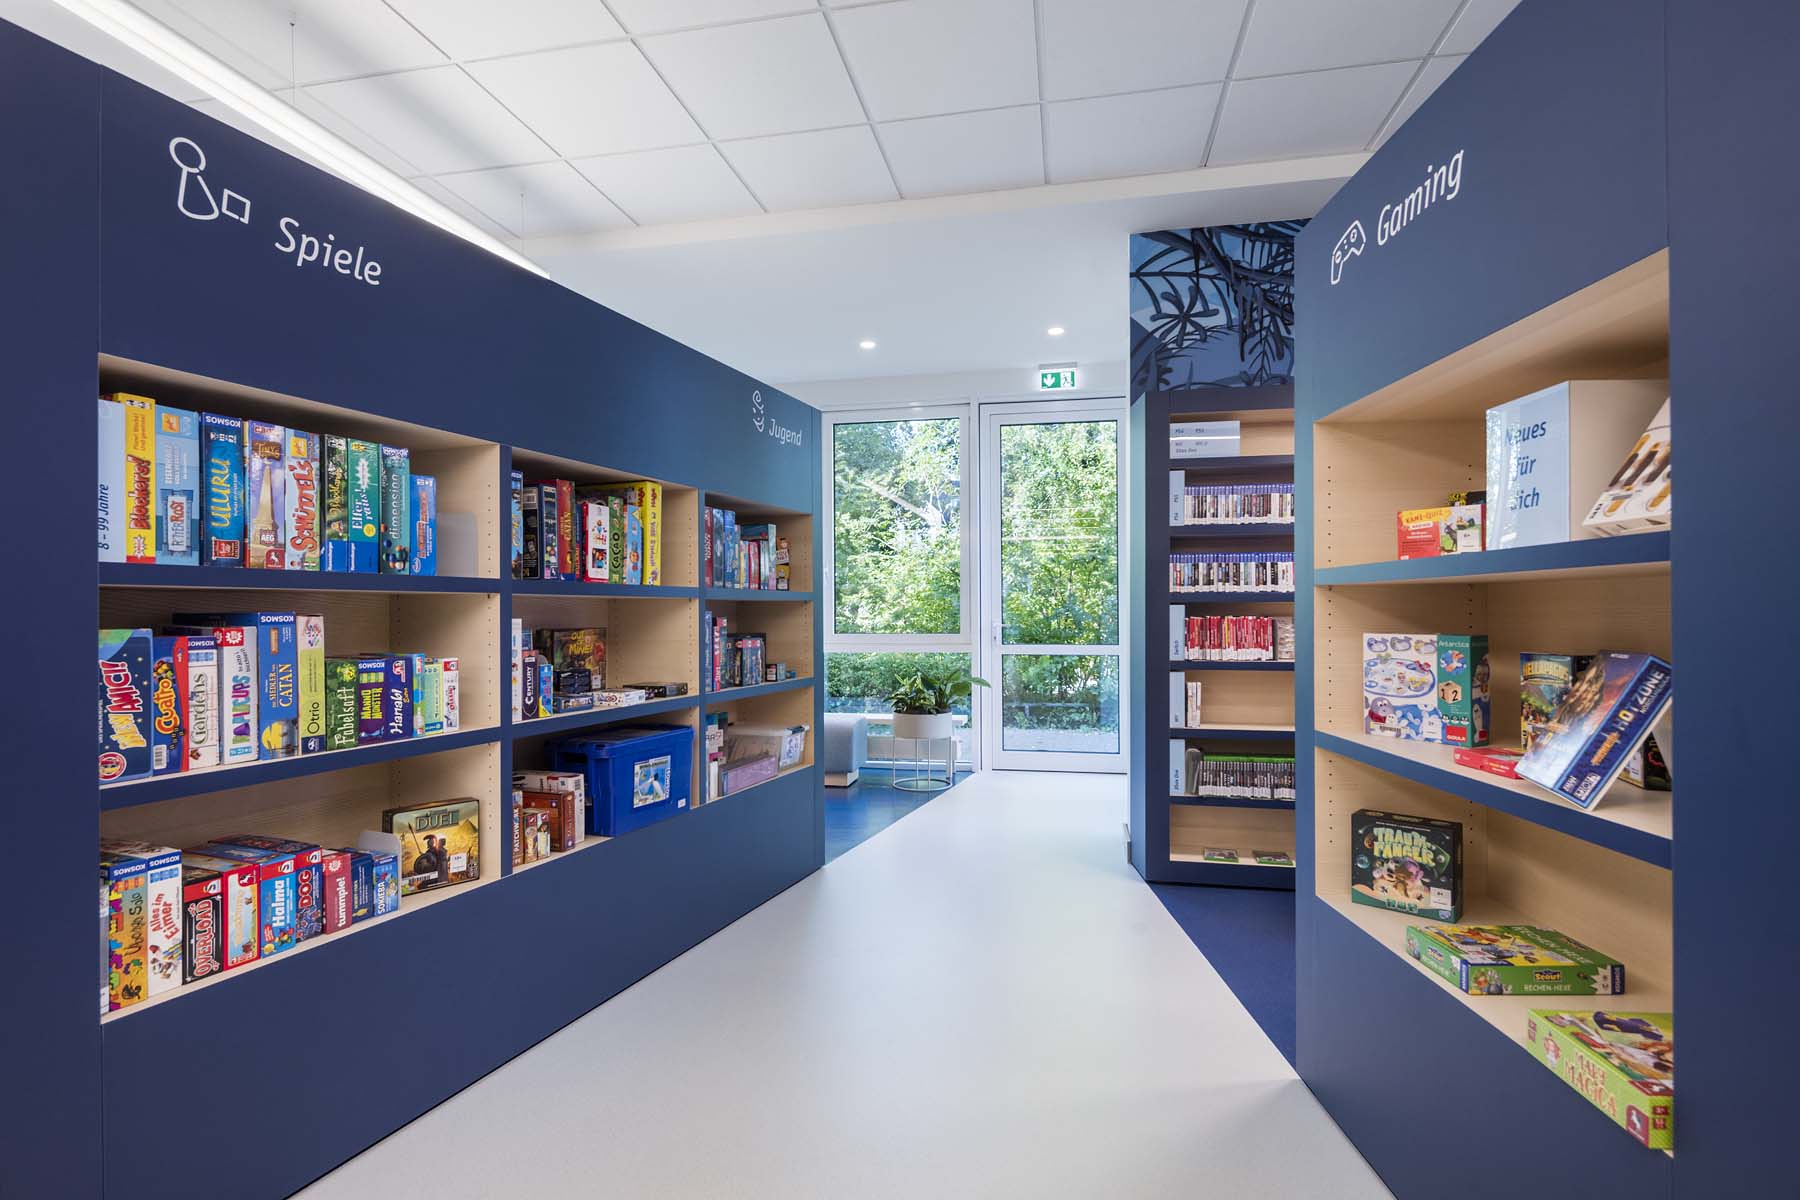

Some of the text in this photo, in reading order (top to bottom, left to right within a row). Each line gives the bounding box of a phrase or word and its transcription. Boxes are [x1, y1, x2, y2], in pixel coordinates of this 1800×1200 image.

[1377, 149, 1465, 246] Gaming
[274, 216, 382, 285] Spiele
[205, 415, 241, 428] KOSMOS
[769, 418, 802, 446] Jugend
[98, 484, 110, 516] Jahre
[127, 454, 152, 530] Blockers!
[210, 458, 231, 528] ULURU
[389, 474, 401, 539] dimension
[1510, 487, 1541, 511] ich
[98, 517, 110, 531] 99
[352, 499, 363, 529] Elfer
[611, 533, 621, 569] CACAO
[261, 615, 294, 623] KOSMOS
[358, 661, 385, 669] KOSMOS
[99, 659, 144, 714] AMICI!
[278, 663, 293, 707] CATAN
[360, 689, 372, 720] MANNO
[371, 687, 383, 719] MONSTER
[525, 666, 534, 705] CENTURY
[1452, 690, 1458, 701] 2
[1612, 671, 1665, 732] HOT ZONE
[154, 678, 180, 735] Cuatro
[189, 672, 209, 746] Gardens
[306, 702, 320, 735] Otrio
[334, 686, 355, 747] Fabelsaft
[389, 688, 404, 735] Hanabi
[416, 810, 459, 831] DUEL
[113, 863, 146, 876] KOSMOS
[149, 855, 180, 867] KOSMOS
[129, 892, 144, 916] Solo
[272, 879, 286, 928] Halma
[298, 871, 313, 910] DOG
[336, 876, 347, 928] tummple!
[151, 893, 165, 933] Alles im
[161, 900, 180, 940] Eimer
[194, 899, 213, 977] OVERLOAD
[1535, 972, 1561, 981] Scout
